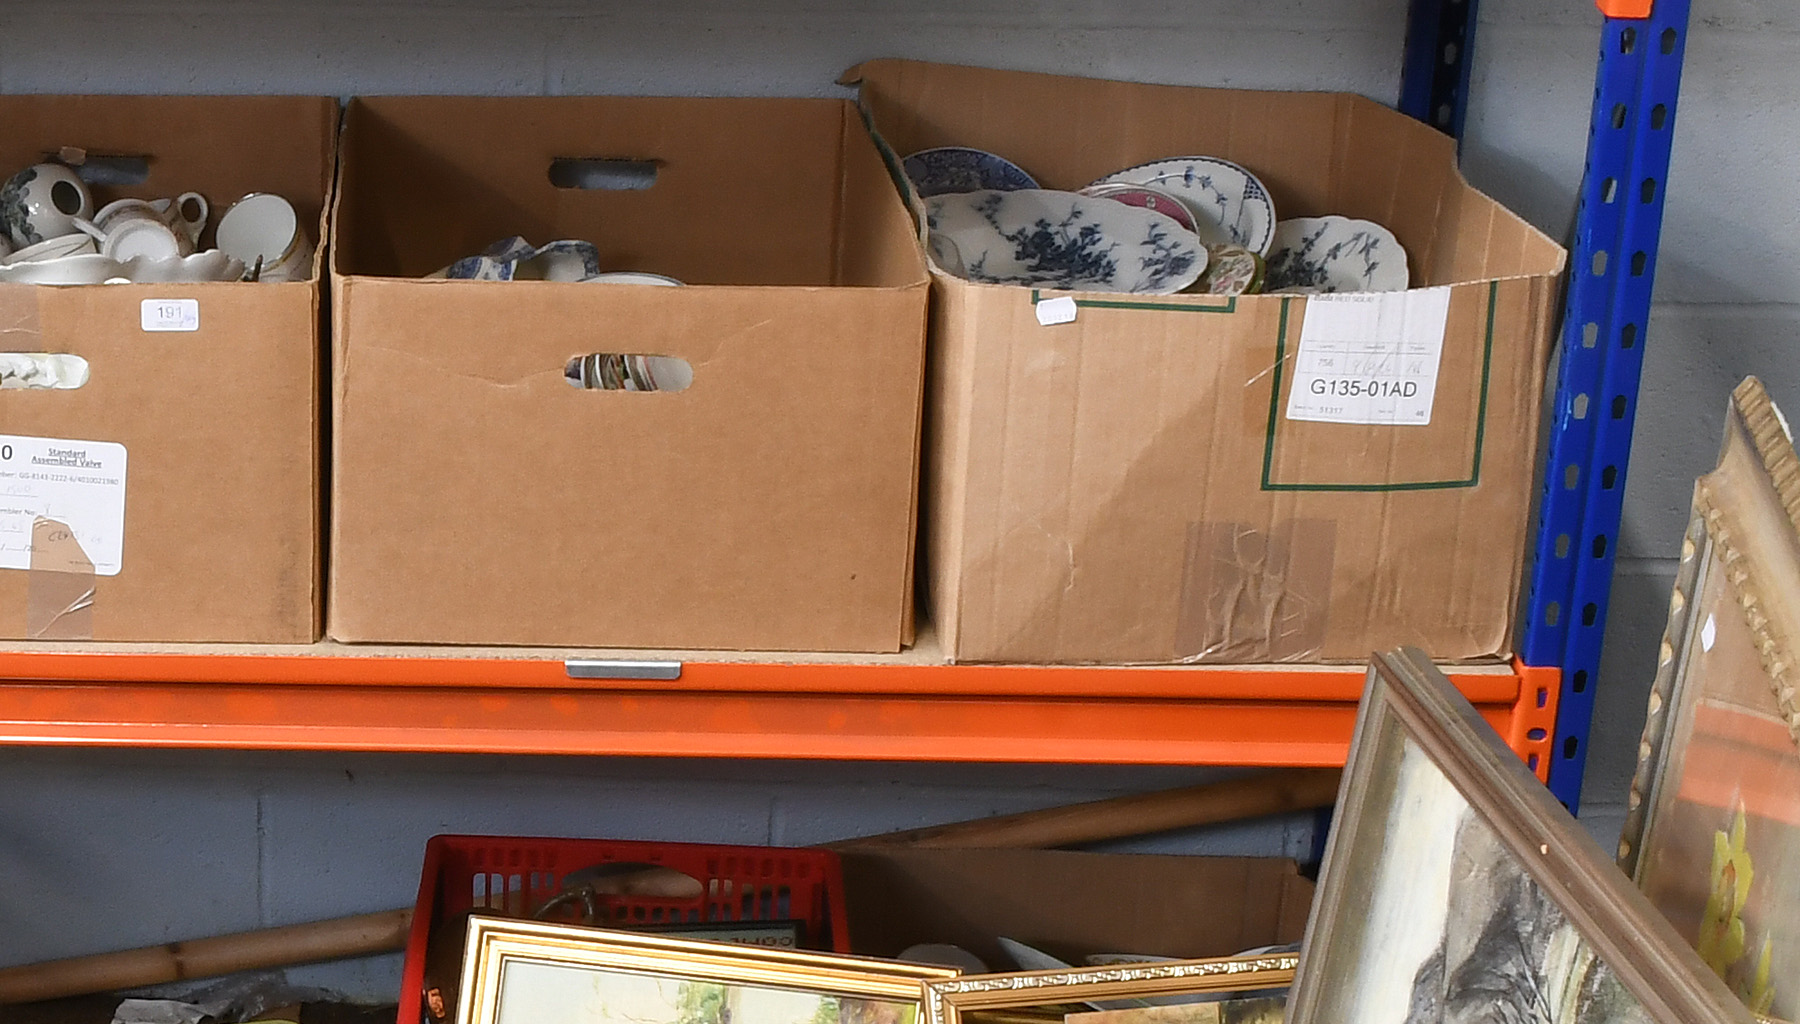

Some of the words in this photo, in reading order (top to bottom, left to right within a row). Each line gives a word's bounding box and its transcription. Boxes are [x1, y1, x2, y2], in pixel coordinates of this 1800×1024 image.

[157, 306, 182, 319] 191
[1310, 378, 1418, 398] G135-01AD
[48, 447, 86, 458] Standard
[31, 455, 77, 467] Assembled
[79, 458, 102, 468] Valve
